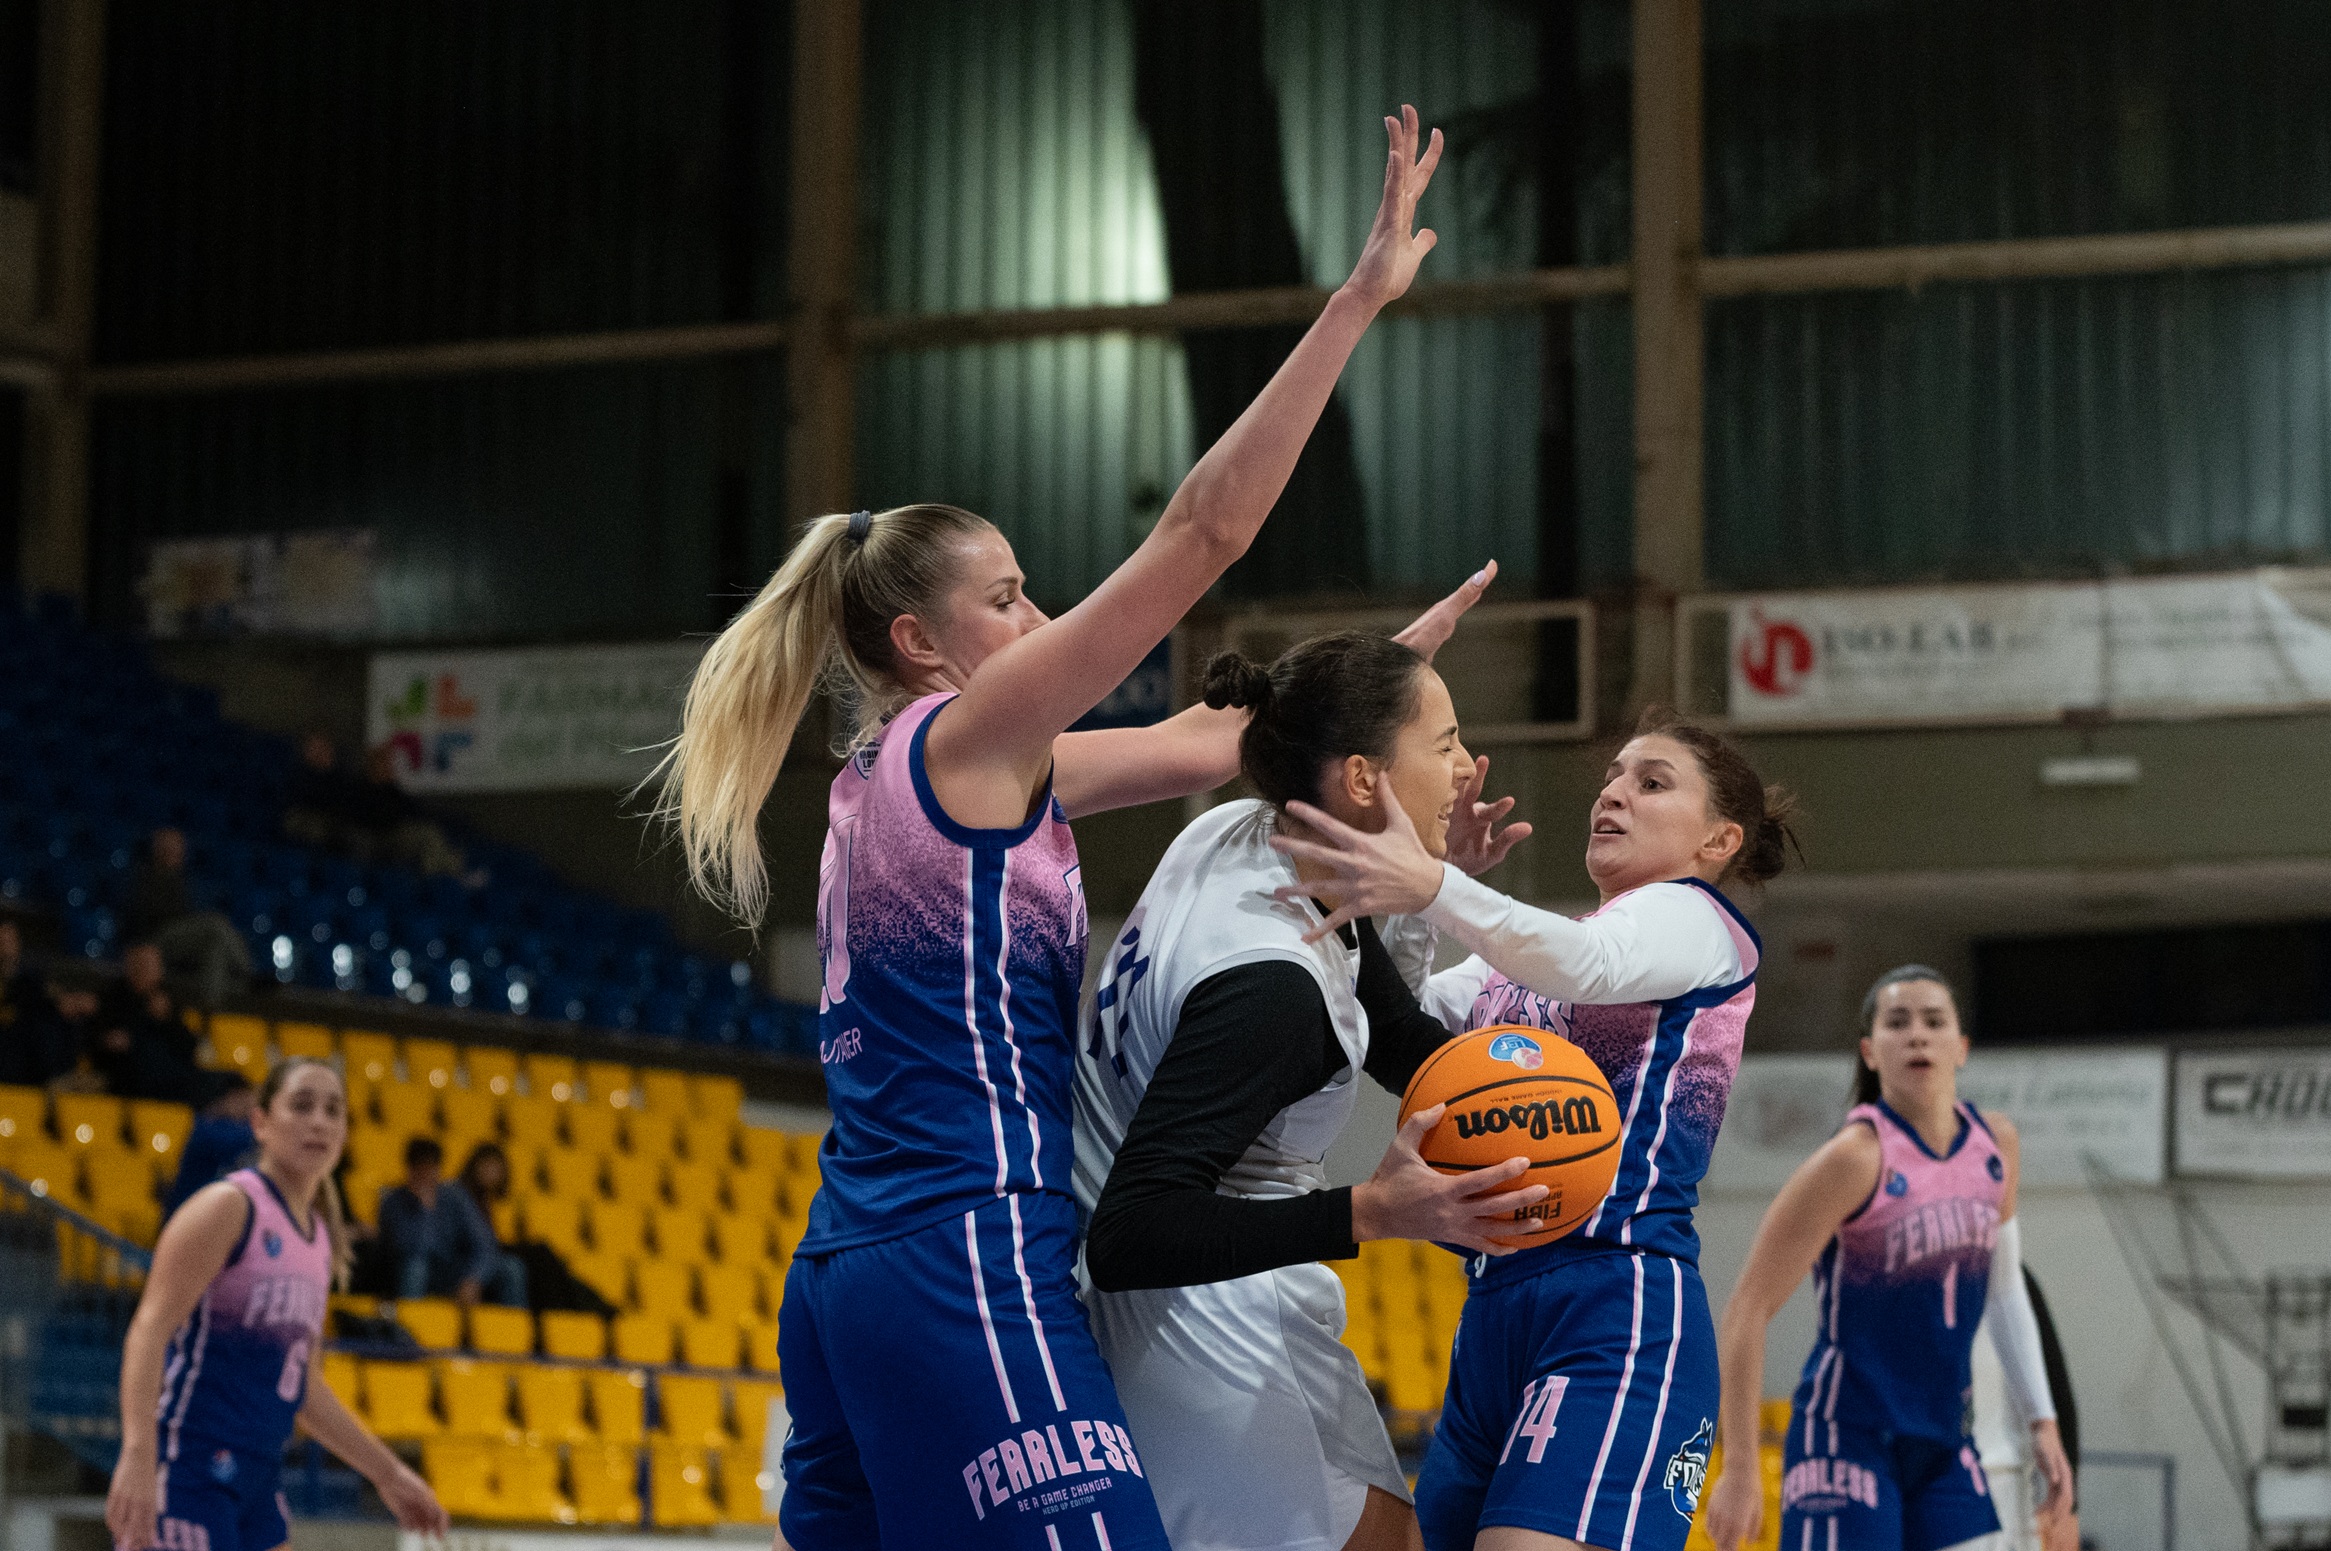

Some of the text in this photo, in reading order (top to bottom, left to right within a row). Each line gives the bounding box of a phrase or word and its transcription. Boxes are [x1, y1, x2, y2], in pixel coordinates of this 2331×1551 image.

[1511, 1092, 1534, 1100] GAME
[1454, 1096, 1602, 1141] Wilson
[1514, 1201, 1561, 1222] FIBA
[1943, 1262, 1959, 1330] 1
[1499, 1375, 1570, 1465] 14
[962, 1420, 1144, 1521] FEARLESS
[1017, 1476, 1113, 1512] BE A GAME CHANGER
[1070, 1495, 1096, 1508] EDITION
